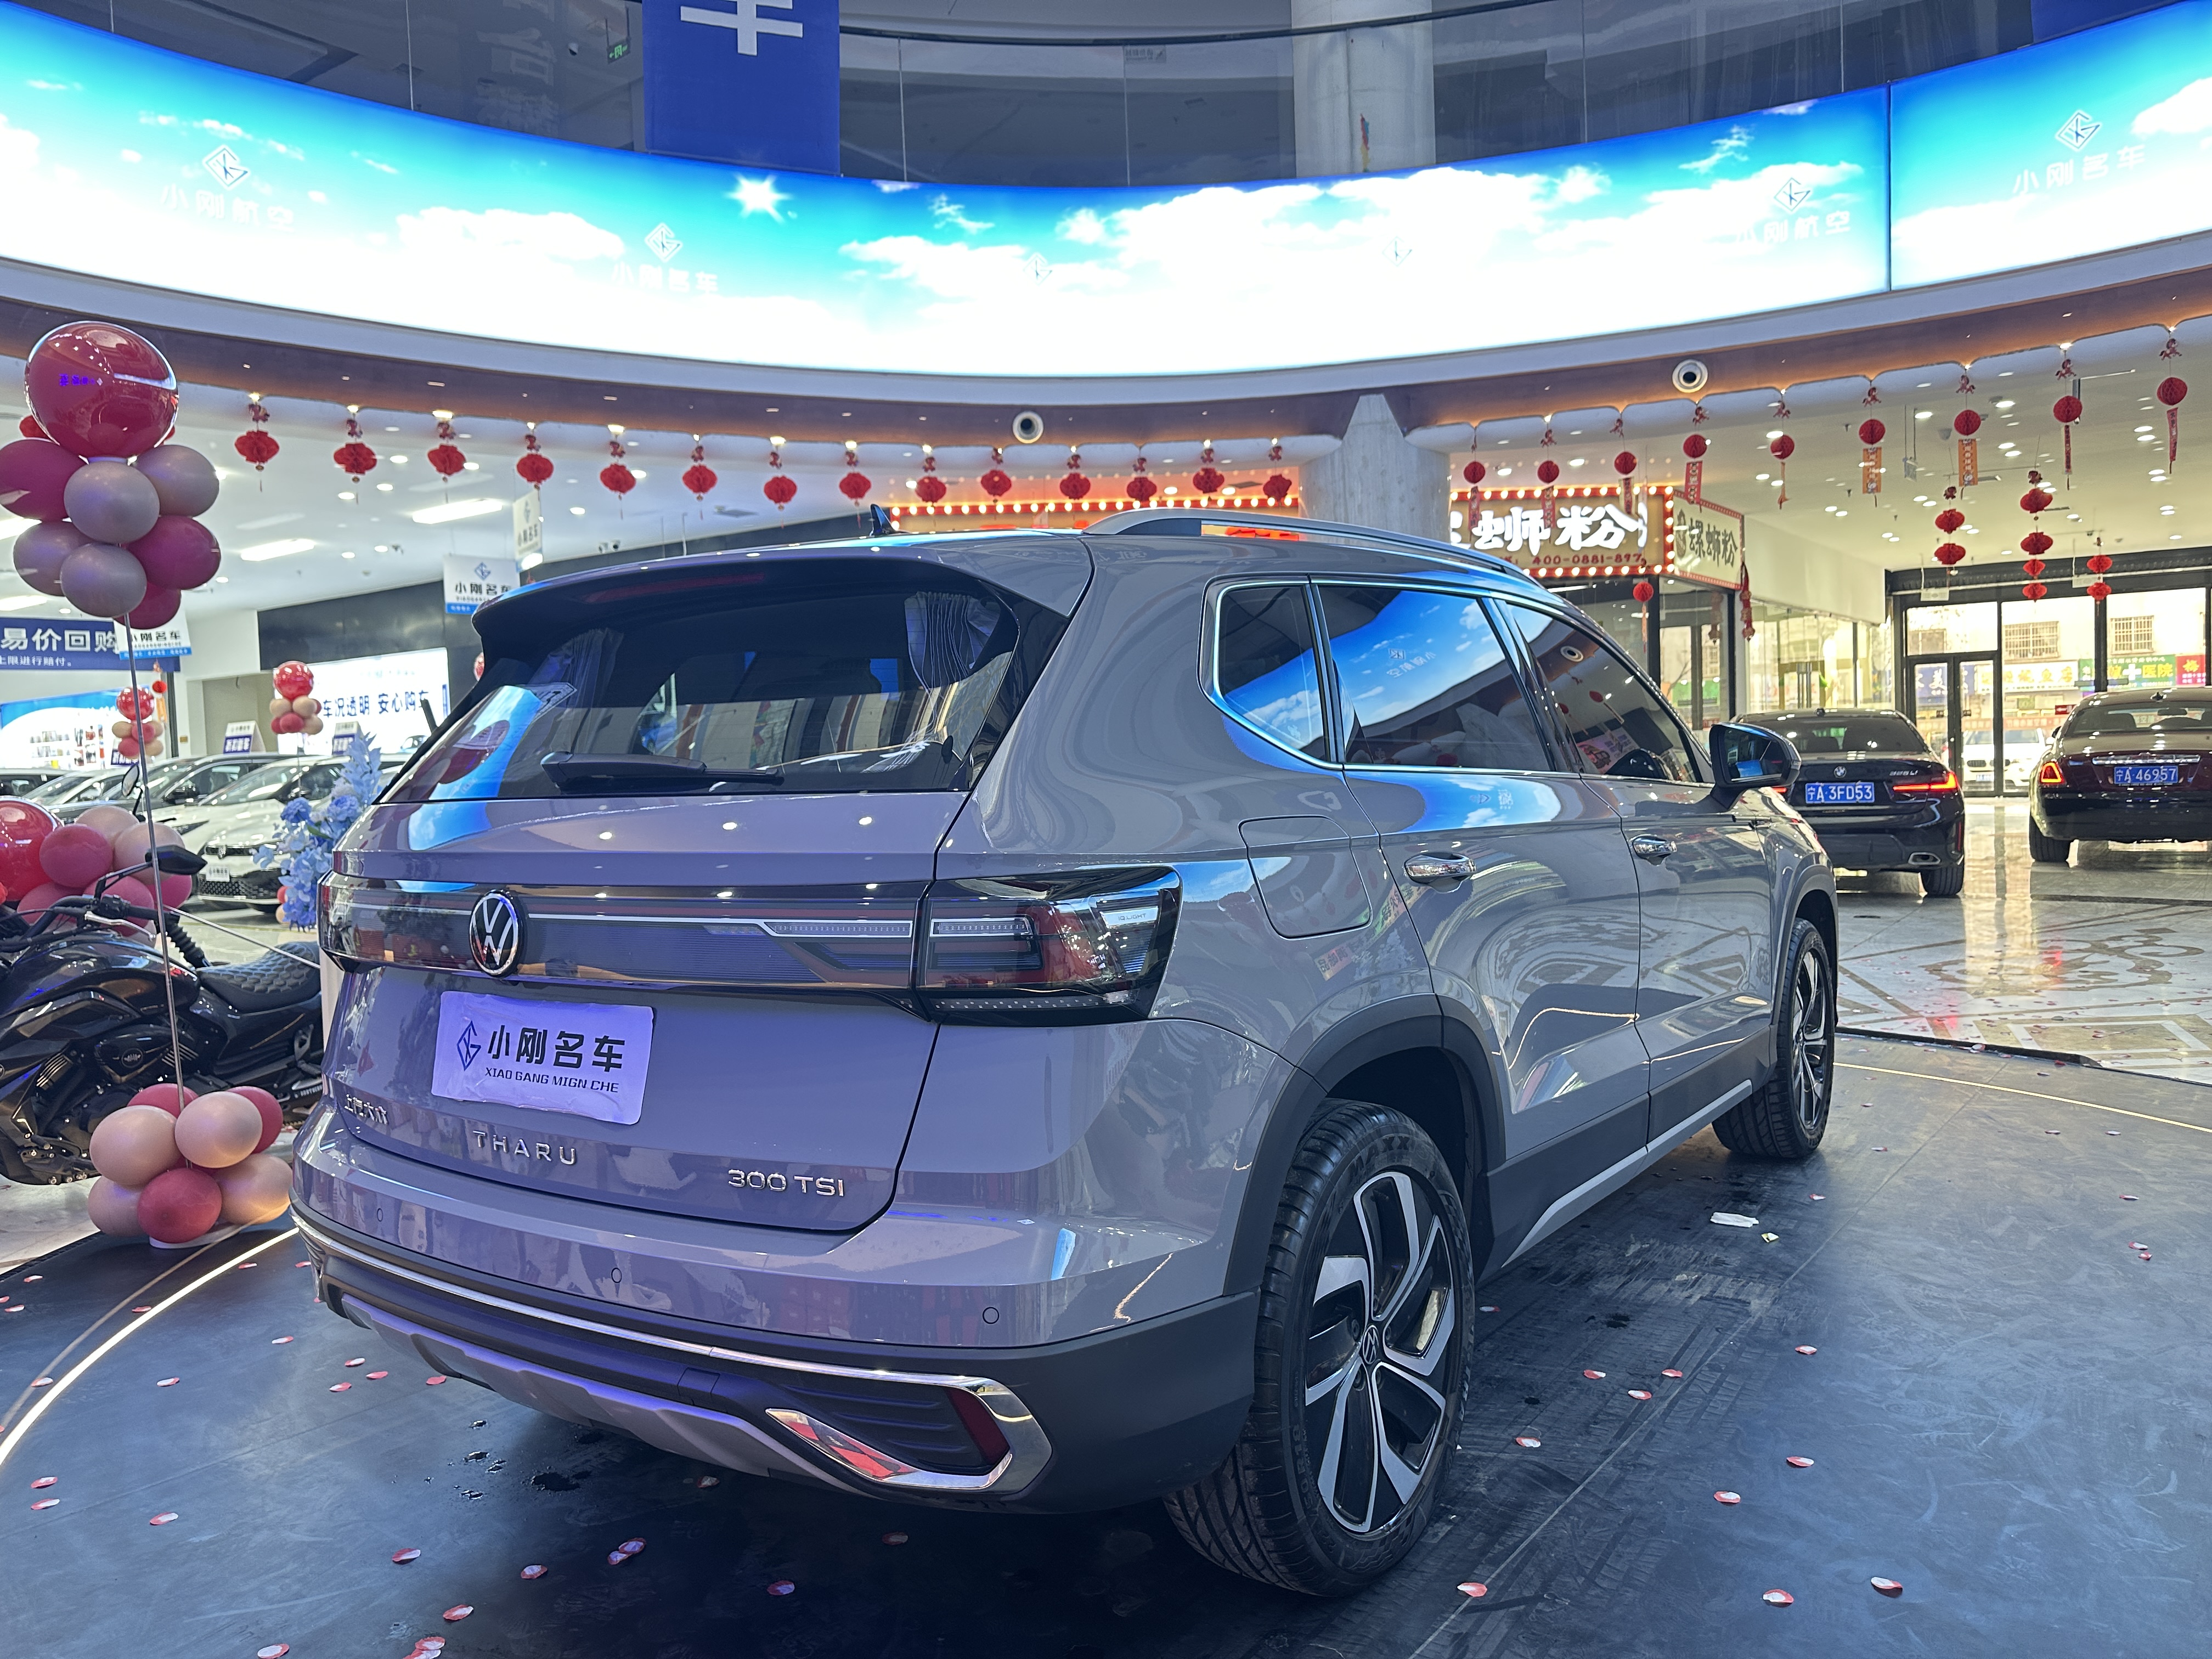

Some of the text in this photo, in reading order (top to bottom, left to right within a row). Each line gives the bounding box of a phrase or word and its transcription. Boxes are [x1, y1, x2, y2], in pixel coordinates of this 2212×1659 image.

[2012, 144, 2146, 193] 小刚名车
[160, 183, 295, 233] 小刚航空
[1737, 210, 1851, 245] 小刚航空
[612, 261, 718, 294] 小刚名车
[1, 628, 117, 653] 易价回购
[323, 695, 370, 718] 车况透明
[488, 1025, 625, 1072] 小刚名车
[485, 1067, 619, 1093] XIAO GANG MIGN CHE
[473, 1130, 576, 1166] THARU
[728, 1169, 844, 1197] 300 TSI
